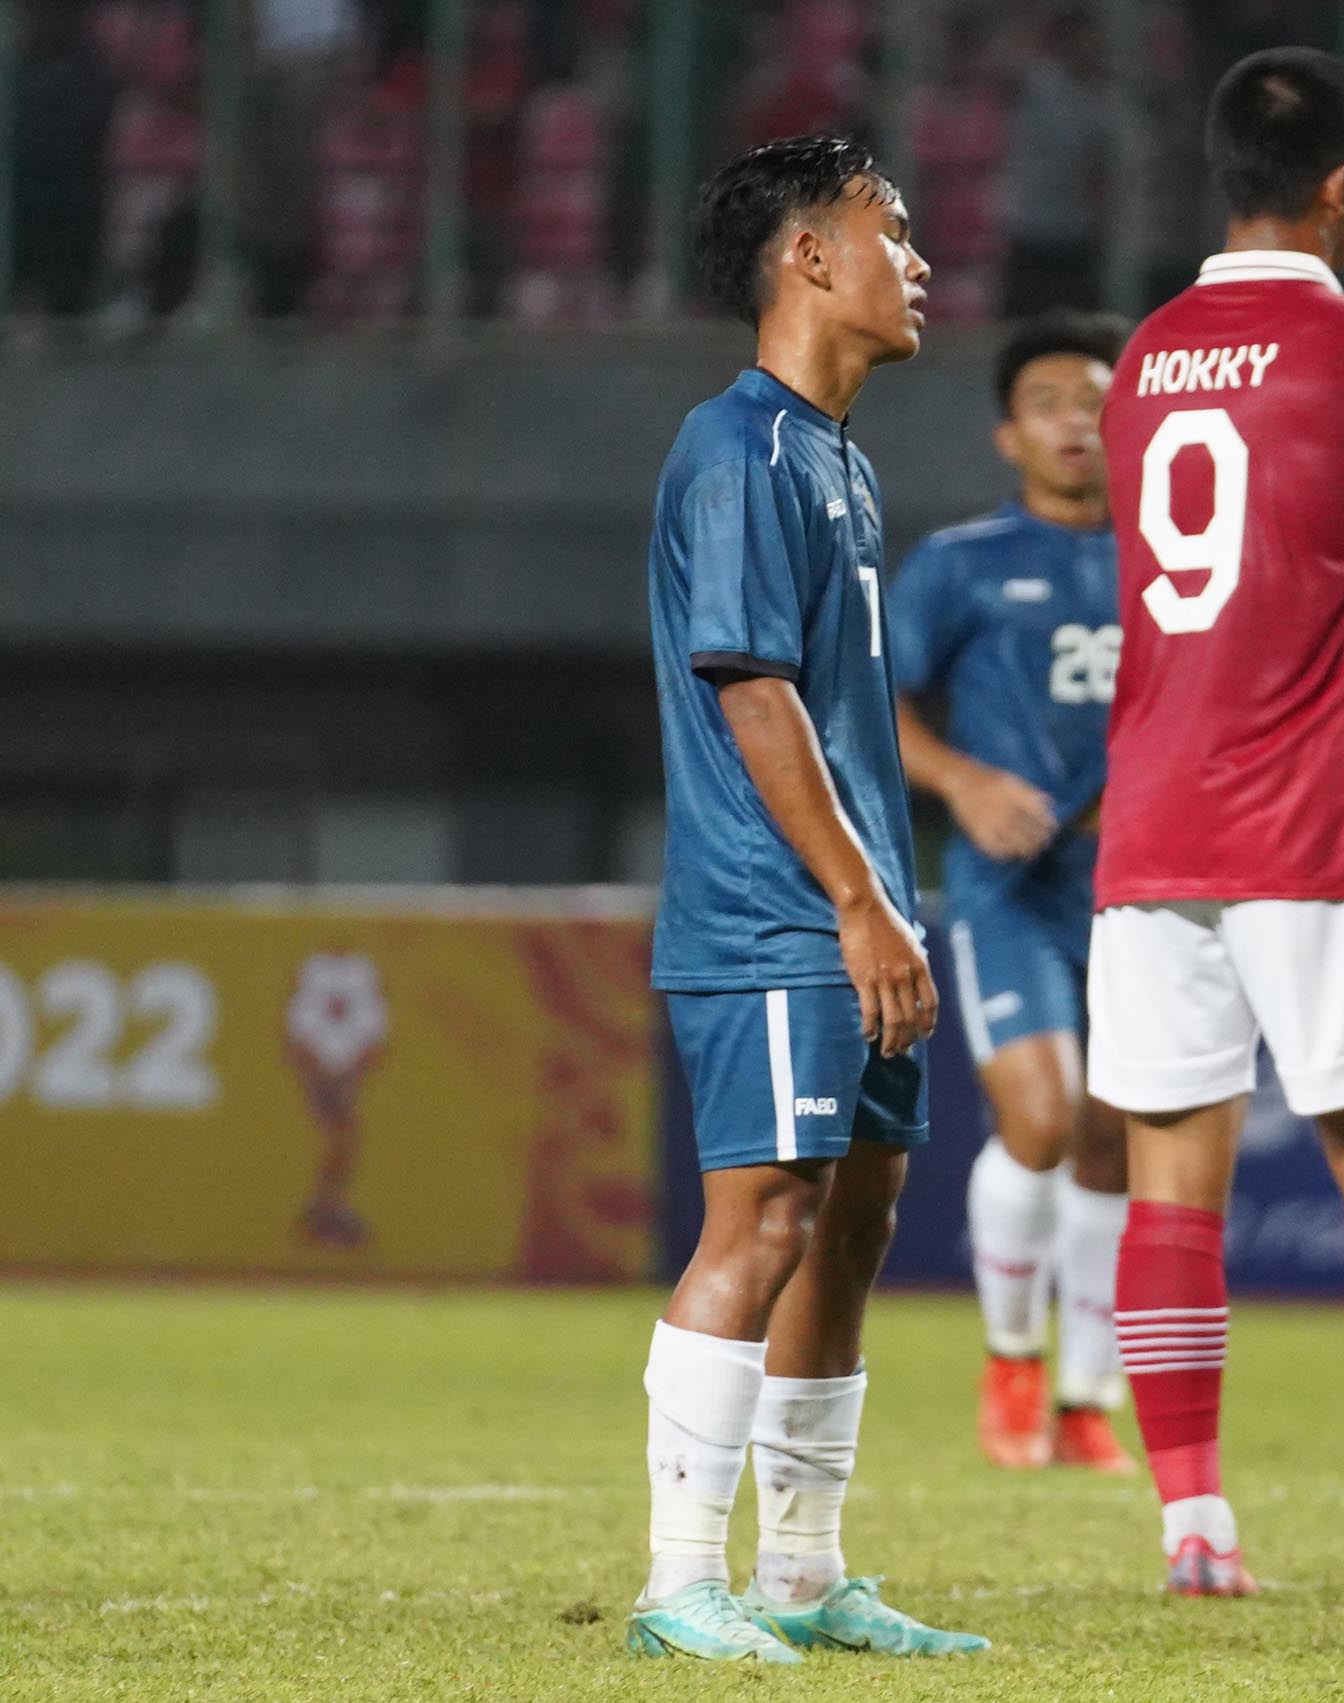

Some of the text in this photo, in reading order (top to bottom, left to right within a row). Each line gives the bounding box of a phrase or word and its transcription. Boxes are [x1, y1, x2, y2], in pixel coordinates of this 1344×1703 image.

[1137, 343, 1279, 397] HOKKY
[1139, 408, 1249, 634] 9
[1051, 622, 1124, 704] 26
